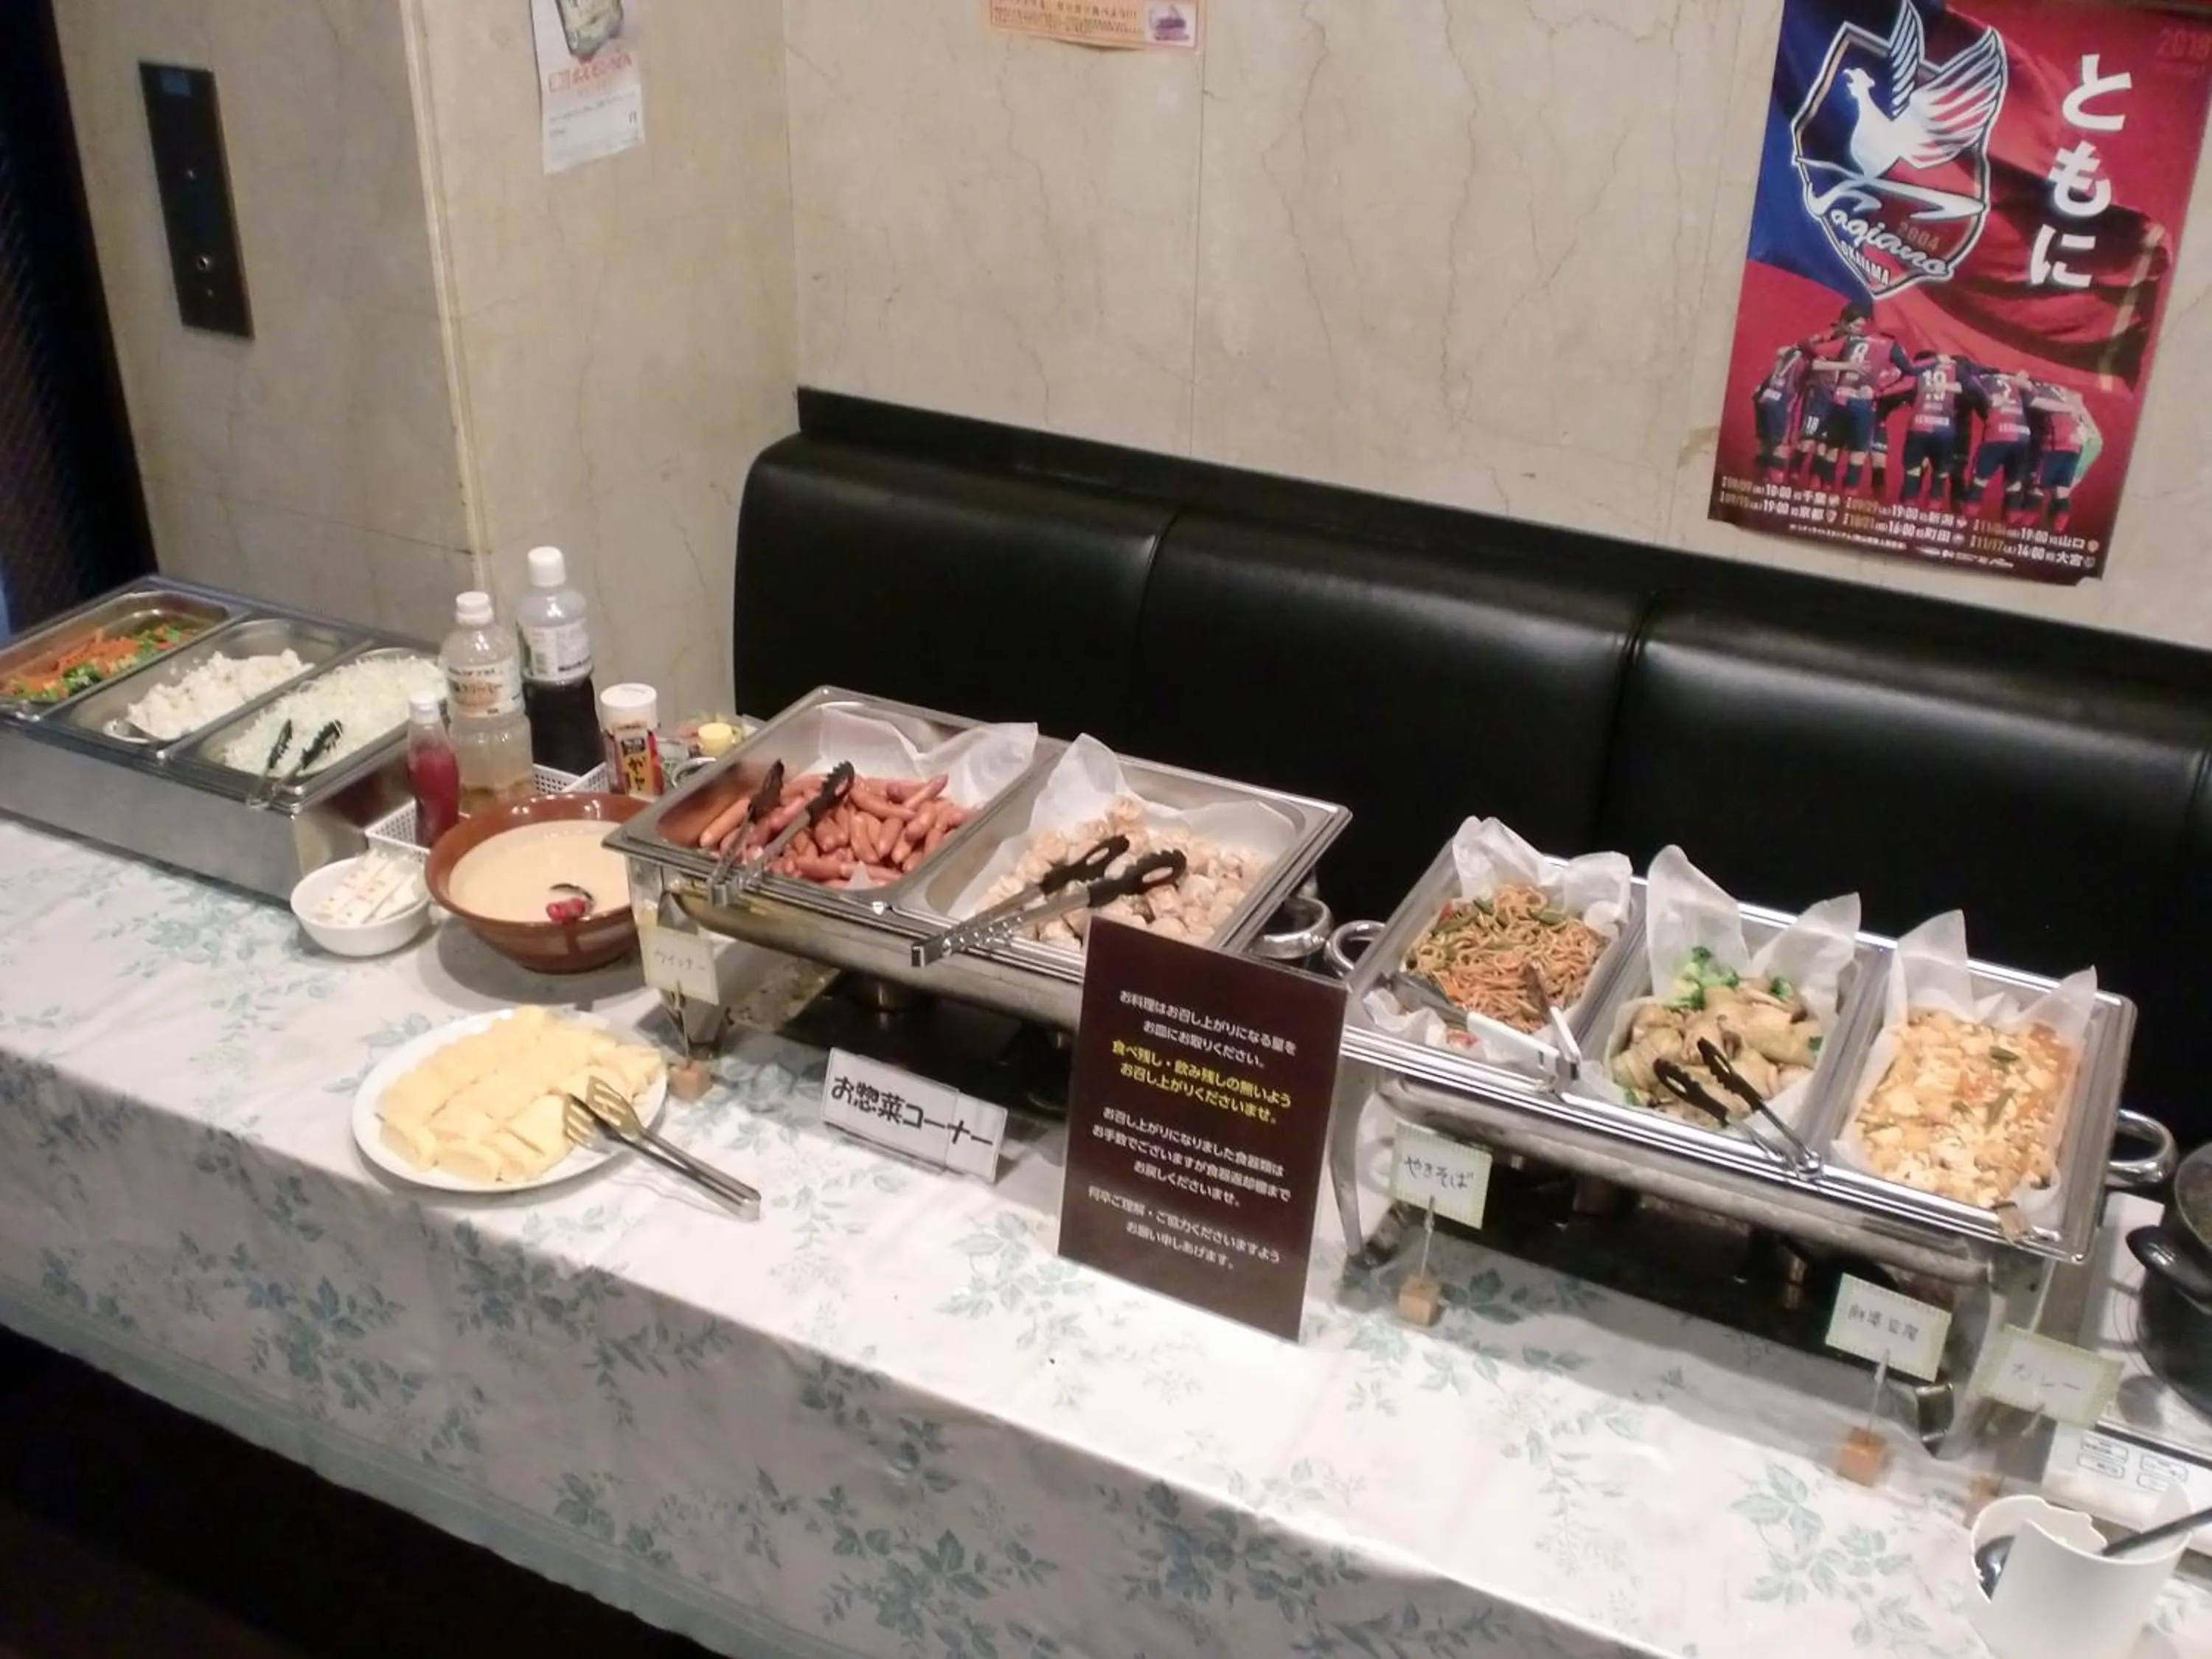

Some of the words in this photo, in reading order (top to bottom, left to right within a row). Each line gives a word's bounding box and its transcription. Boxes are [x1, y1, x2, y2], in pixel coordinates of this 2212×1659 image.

[2028, 54, 2132, 289] ともに
[1897, 222, 1941, 251] 2004
[2056, 551, 2084, 568] 大宮
[2059, 534, 2085, 549] 山口
[1143, 1020, 1265, 1069] お皿にお取りください。
[830, 1075, 994, 1147] お惣菜コーナー
[1120, 1062, 1277, 1124] お召し上がりくださいませ。
[1404, 1155, 1475, 1189] やきそば
